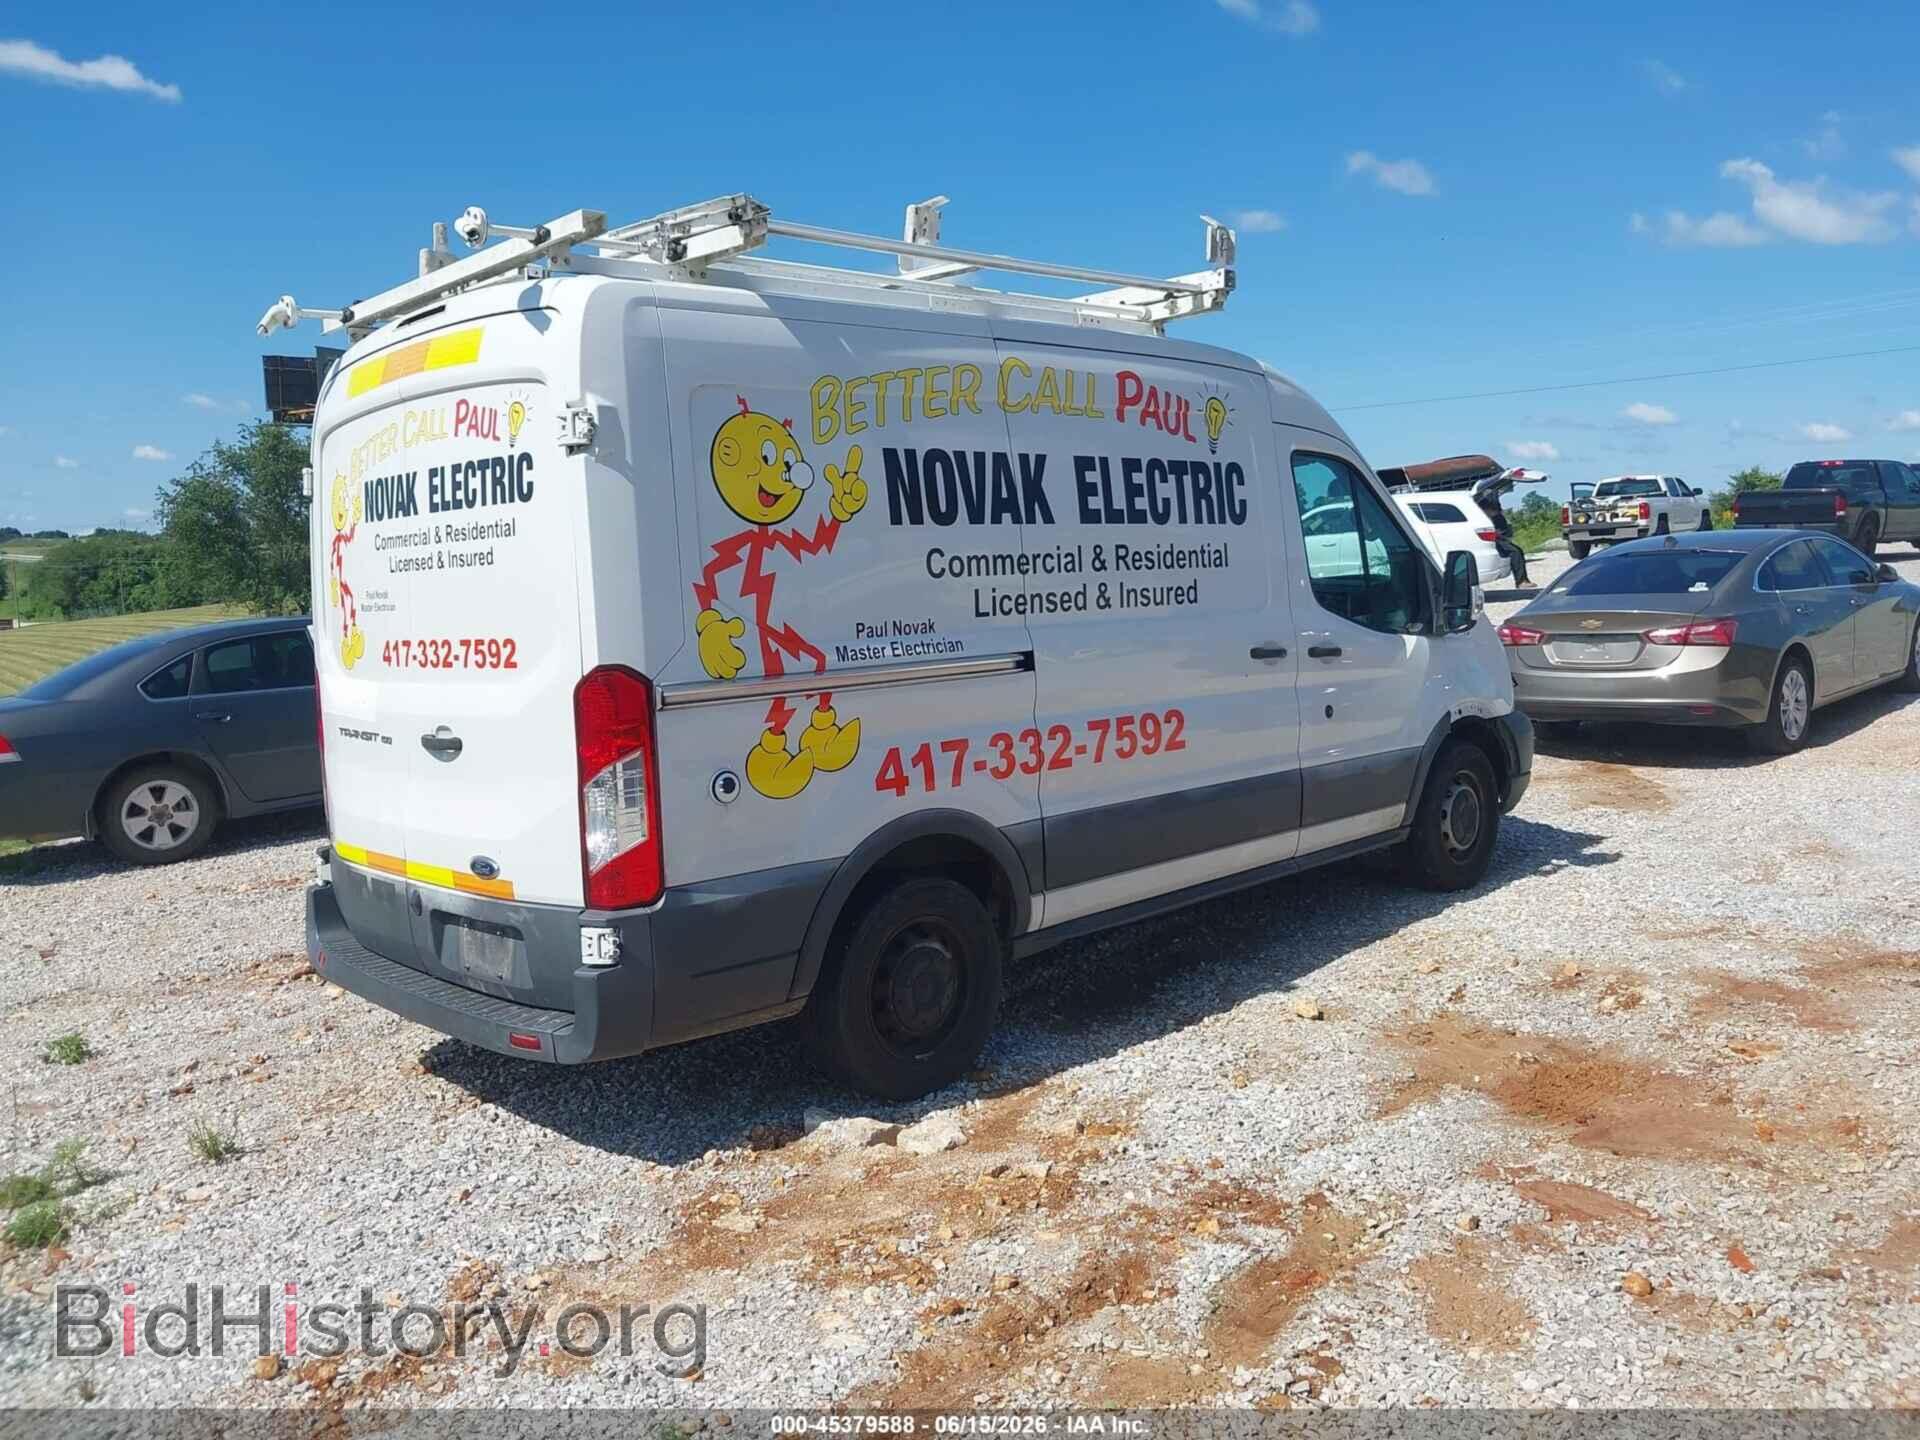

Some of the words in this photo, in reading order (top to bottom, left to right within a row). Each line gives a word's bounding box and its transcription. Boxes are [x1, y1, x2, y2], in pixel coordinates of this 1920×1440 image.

[810, 362, 983, 445] BETTER
[996, 356, 1105, 420] CALL
[1115, 369, 1197, 444] PAUL
[403, 408, 449, 449] CALL
[453, 398, 501, 442] PAUL
[364, 471, 419, 524] NOVAK
[428, 451, 535, 514] ELECTRIC
[882, 447, 1056, 526] NOVAK
[1073, 455, 1248, 526] ELECTRIC
[374, 527, 431, 551] Commercial
[434, 525, 442, 545] &
[445, 517, 516, 543] Residential
[389, 551, 434, 574] Licensed
[437, 550, 445, 569] &
[448, 546, 494, 569] Insured
[925, 544, 1084, 579] Commercial
[1091, 545, 1108, 572] &
[1115, 542, 1230, 571] Residential
[973, 583, 1088, 619] Licensed
[1095, 582, 1112, 610] &
[1118, 579, 1199, 608] Insured
[856, 620, 888, 640] Paul
[892, 618, 936, 637] Novak
[382, 637, 518, 669] 417-332-7592
[835, 644, 887, 663] Master
[890, 638, 965, 658] Electrician
[874, 708, 1187, 798] 417-332-7592
